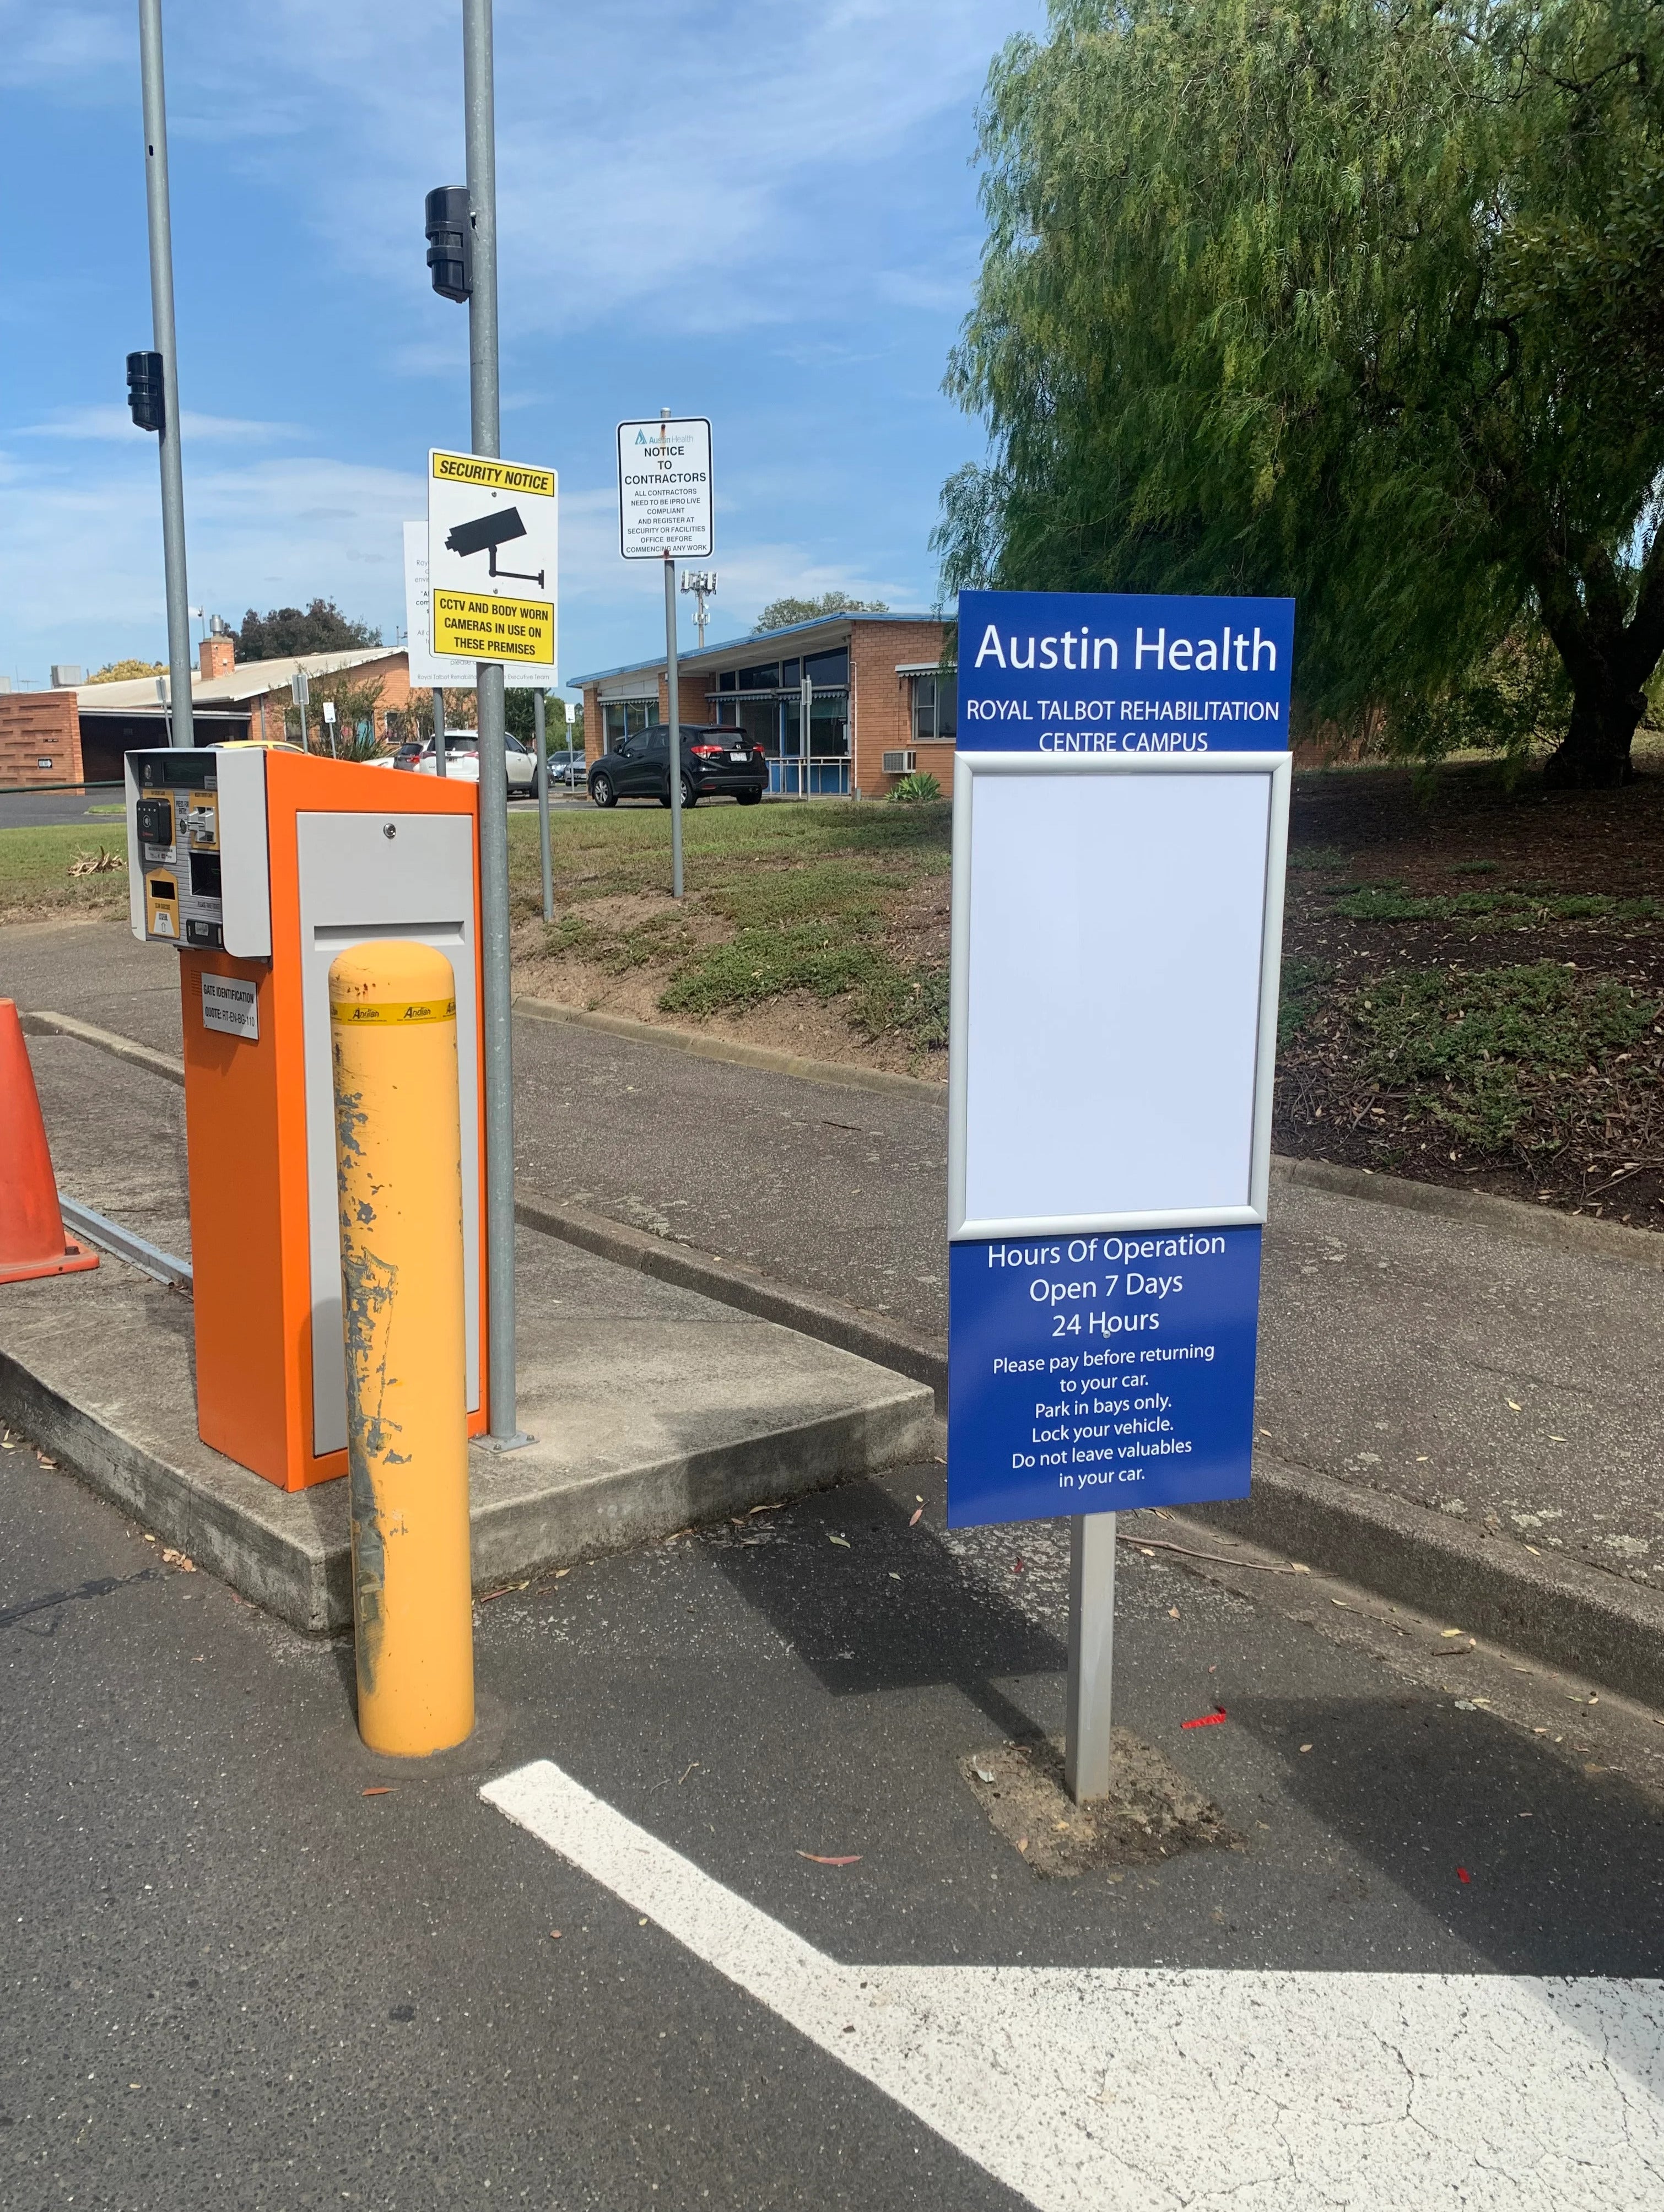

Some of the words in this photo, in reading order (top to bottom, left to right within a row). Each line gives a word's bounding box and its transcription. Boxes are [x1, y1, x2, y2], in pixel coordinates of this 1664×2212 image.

[672, 435, 693, 443] Health
[645, 446, 684, 457] NOTICE
[440, 460, 503, 482] SECURITY
[504, 471, 549, 490] NOTICE
[657, 460, 672, 470] TO
[625, 472, 706, 485] CONTRACTORS
[647, 488, 697, 496] CONTRACTORS
[440, 598, 466, 611] CCTV
[468, 602, 489, 614] AND
[492, 604, 517, 617] BODY
[520, 608, 548, 621] WORN
[445, 617, 492, 632] CAMERAS
[495, 623, 505, 634] IN
[508, 624, 526, 636] USE
[528, 627, 541, 638] ON
[454, 637, 485, 650] THESE
[488, 640, 535, 655] PREMISES
[975, 625, 1117, 669] Austin
[1135, 627, 1276, 671] Health
[968, 700, 1033, 720] ROYAL
[1037, 701, 1115, 720] TALBOT
[1121, 701, 1279, 721] REHABILITATION
[1039, 732, 1117, 751] CENTRE
[1122, 733, 1208, 751] CAMPUS
[204, 985, 215, 996] GATE
[217, 987, 254, 1004] IDENTIFICATION
[206, 1007, 221, 1019] QUOTE:
[989, 1245, 1060, 1268] Hours
[1068, 1238, 1098, 1262] Of
[1104, 1234, 1225, 1264] Operation
[1030, 1279, 1096, 1306] Open
[1105, 1275, 1119, 1296] 7
[1127, 1273, 1182, 1299] Days
[1052, 1314, 1082, 1337] 24
[1089, 1311, 1160, 1334] Hours
[994, 1358, 1045, 1373] Please
[1050, 1356, 1079, 1373] pay
[1084, 1349, 1135, 1366] before
[1141, 1344, 1214, 1362] returning
[1060, 1380, 1077, 1392] to
[1081, 1377, 1118, 1394] your
[1122, 1375, 1148, 1387] car.
[1036, 1400, 1070, 1418] Park
[1075, 1400, 1088, 1415] in
[1094, 1398, 1130, 1416] bays
[1134, 1393, 1171, 1411] only.
[1032, 1427, 1070, 1443] Lock
[1073, 1425, 1110, 1443] your
[1114, 1416, 1174, 1435] vehicle.
[1013, 1453, 1035, 1468] Do
[1040, 1451, 1067, 1465] not
[1072, 1447, 1113, 1463] leave
[1117, 1438, 1192, 1458] valuables
[1060, 1473, 1073, 1488] in
[1078, 1472, 1115, 1490] your
[1119, 1469, 1144, 1481] car.
